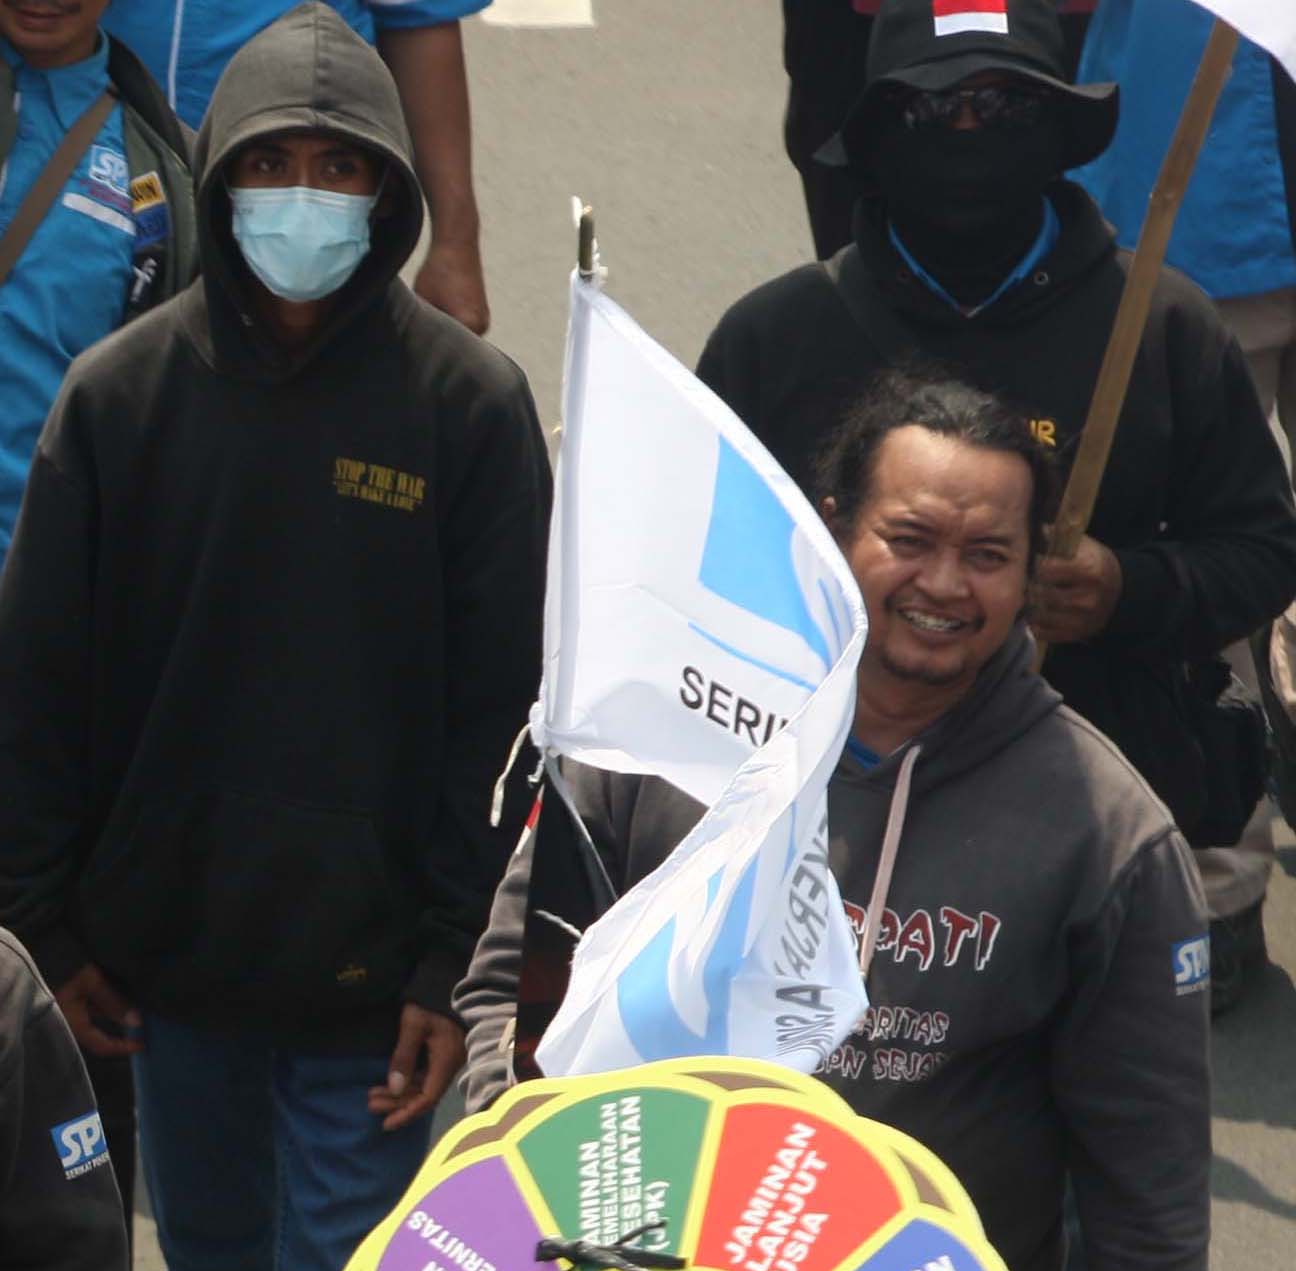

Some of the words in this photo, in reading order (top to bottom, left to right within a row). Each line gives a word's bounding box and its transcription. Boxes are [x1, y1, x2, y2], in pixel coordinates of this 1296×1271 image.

[679, 665, 790, 748] SERI
[578, 1140, 602, 1248] AMINAN
[599, 1102, 619, 1247] EMELIHARAAN
[724, 1122, 817, 1264] JAMINAN
